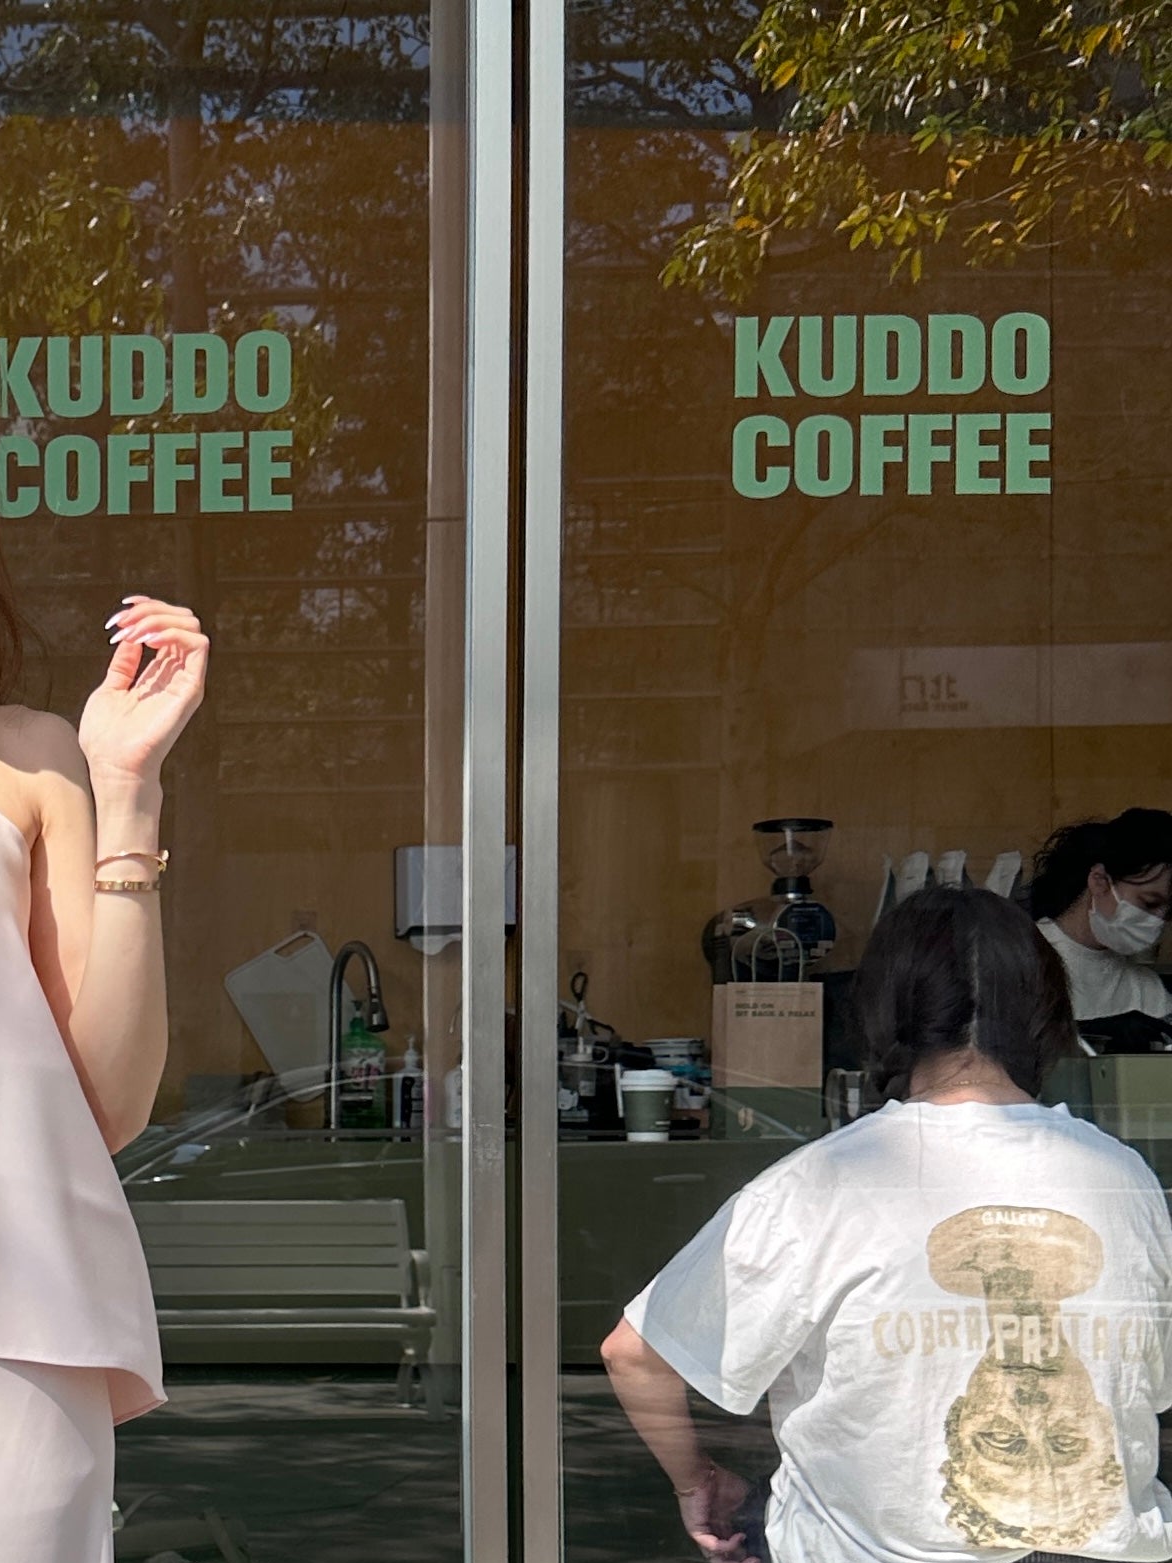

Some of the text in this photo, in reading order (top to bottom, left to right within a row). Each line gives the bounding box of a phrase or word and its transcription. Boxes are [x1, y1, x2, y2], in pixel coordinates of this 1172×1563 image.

[734, 312, 1051, 398] KUDDO
[732, 413, 1052, 499] COFFEE
[981, 1210, 1048, 1228] GALLERY
